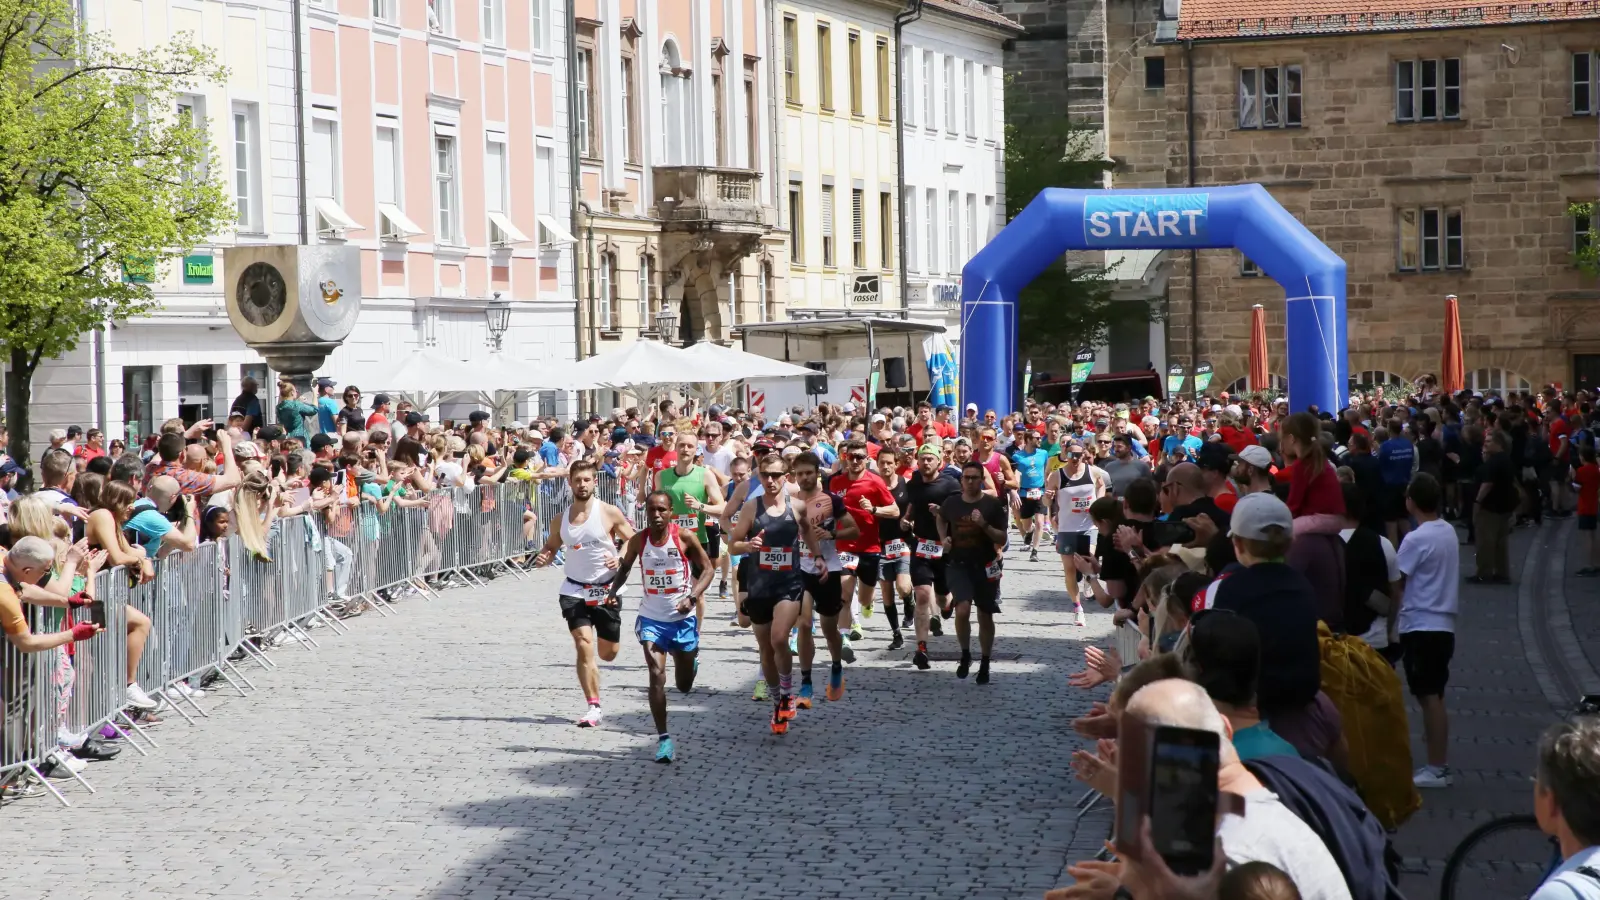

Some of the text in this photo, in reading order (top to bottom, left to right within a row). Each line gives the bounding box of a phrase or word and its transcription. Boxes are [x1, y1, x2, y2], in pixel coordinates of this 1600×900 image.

[1090, 209, 1203, 237] START
[853, 294, 879, 303] rosset
[921, 543, 939, 553] 2635
[764, 553, 787, 562] 2501
[650, 576, 673, 586] 2513
